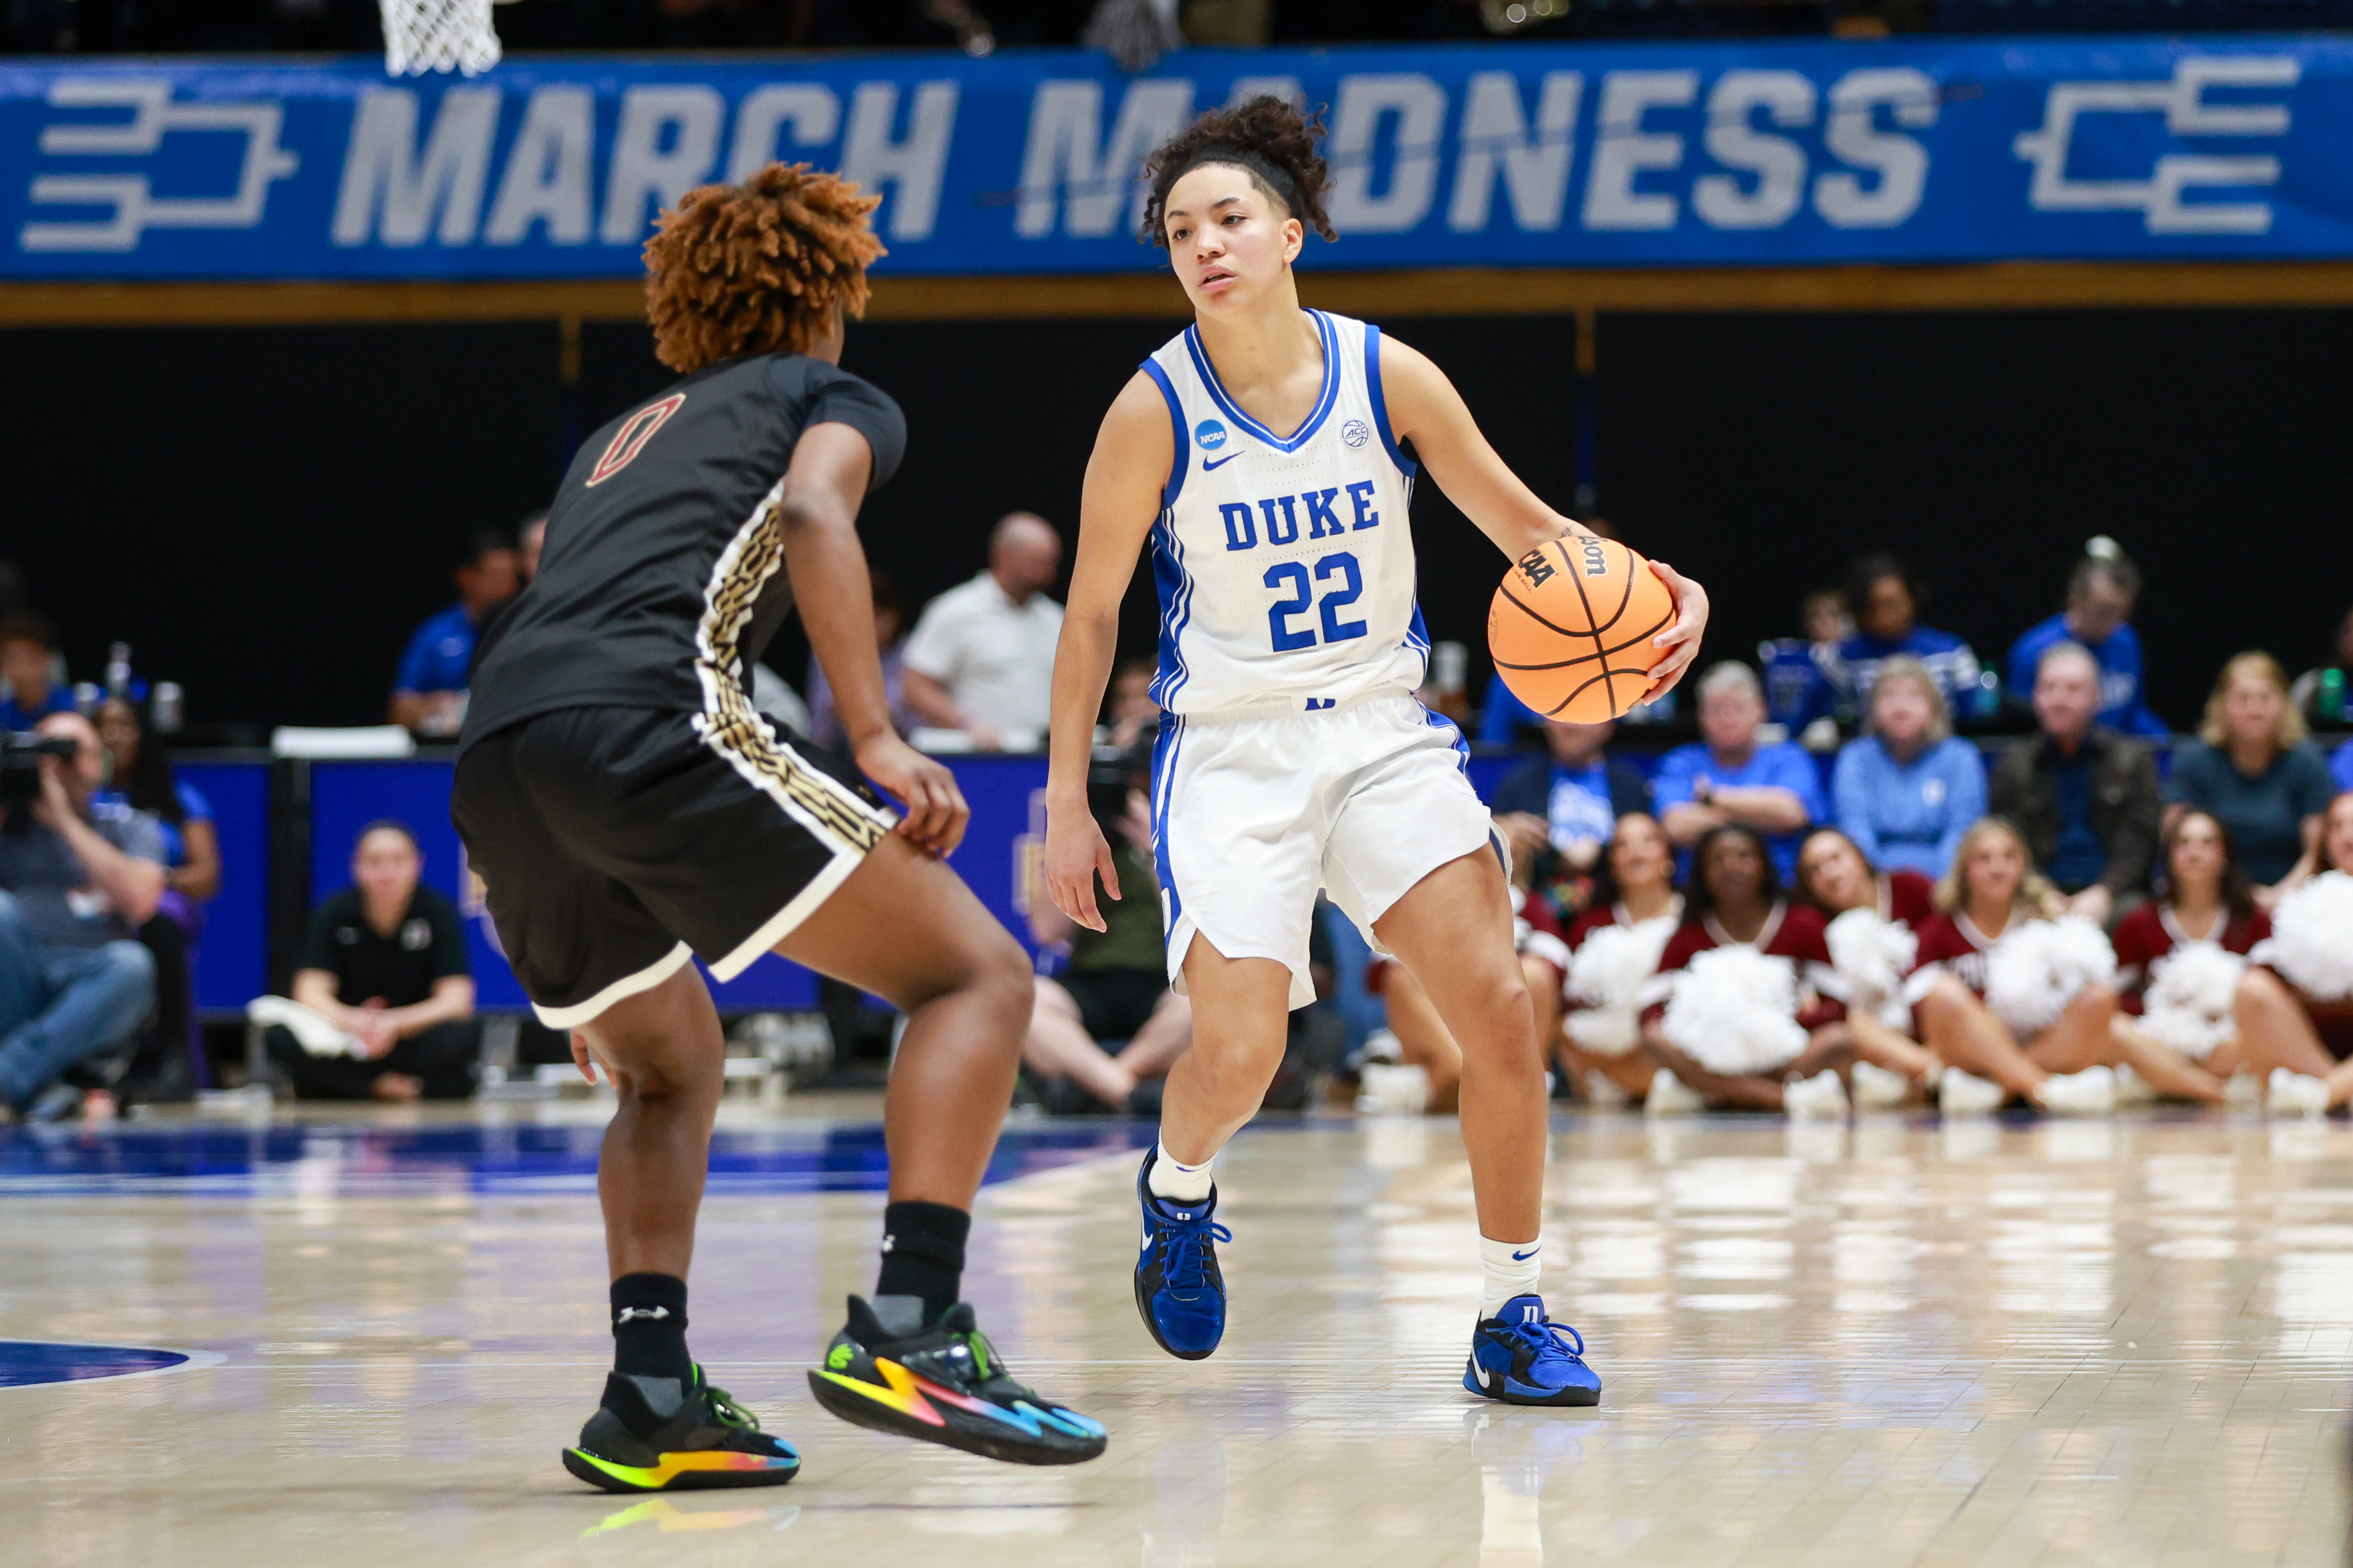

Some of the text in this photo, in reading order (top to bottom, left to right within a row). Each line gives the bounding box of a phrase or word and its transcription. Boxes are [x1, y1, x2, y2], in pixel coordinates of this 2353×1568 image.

[1013, 68, 1941, 239] MDNESS
[585, 391, 687, 489] 0
[1200, 431, 1226, 444] NCAA
[1346, 426, 1366, 437] ACC
[1219, 479, 1379, 551] DUKE
[1263, 551, 1368, 652] 22
